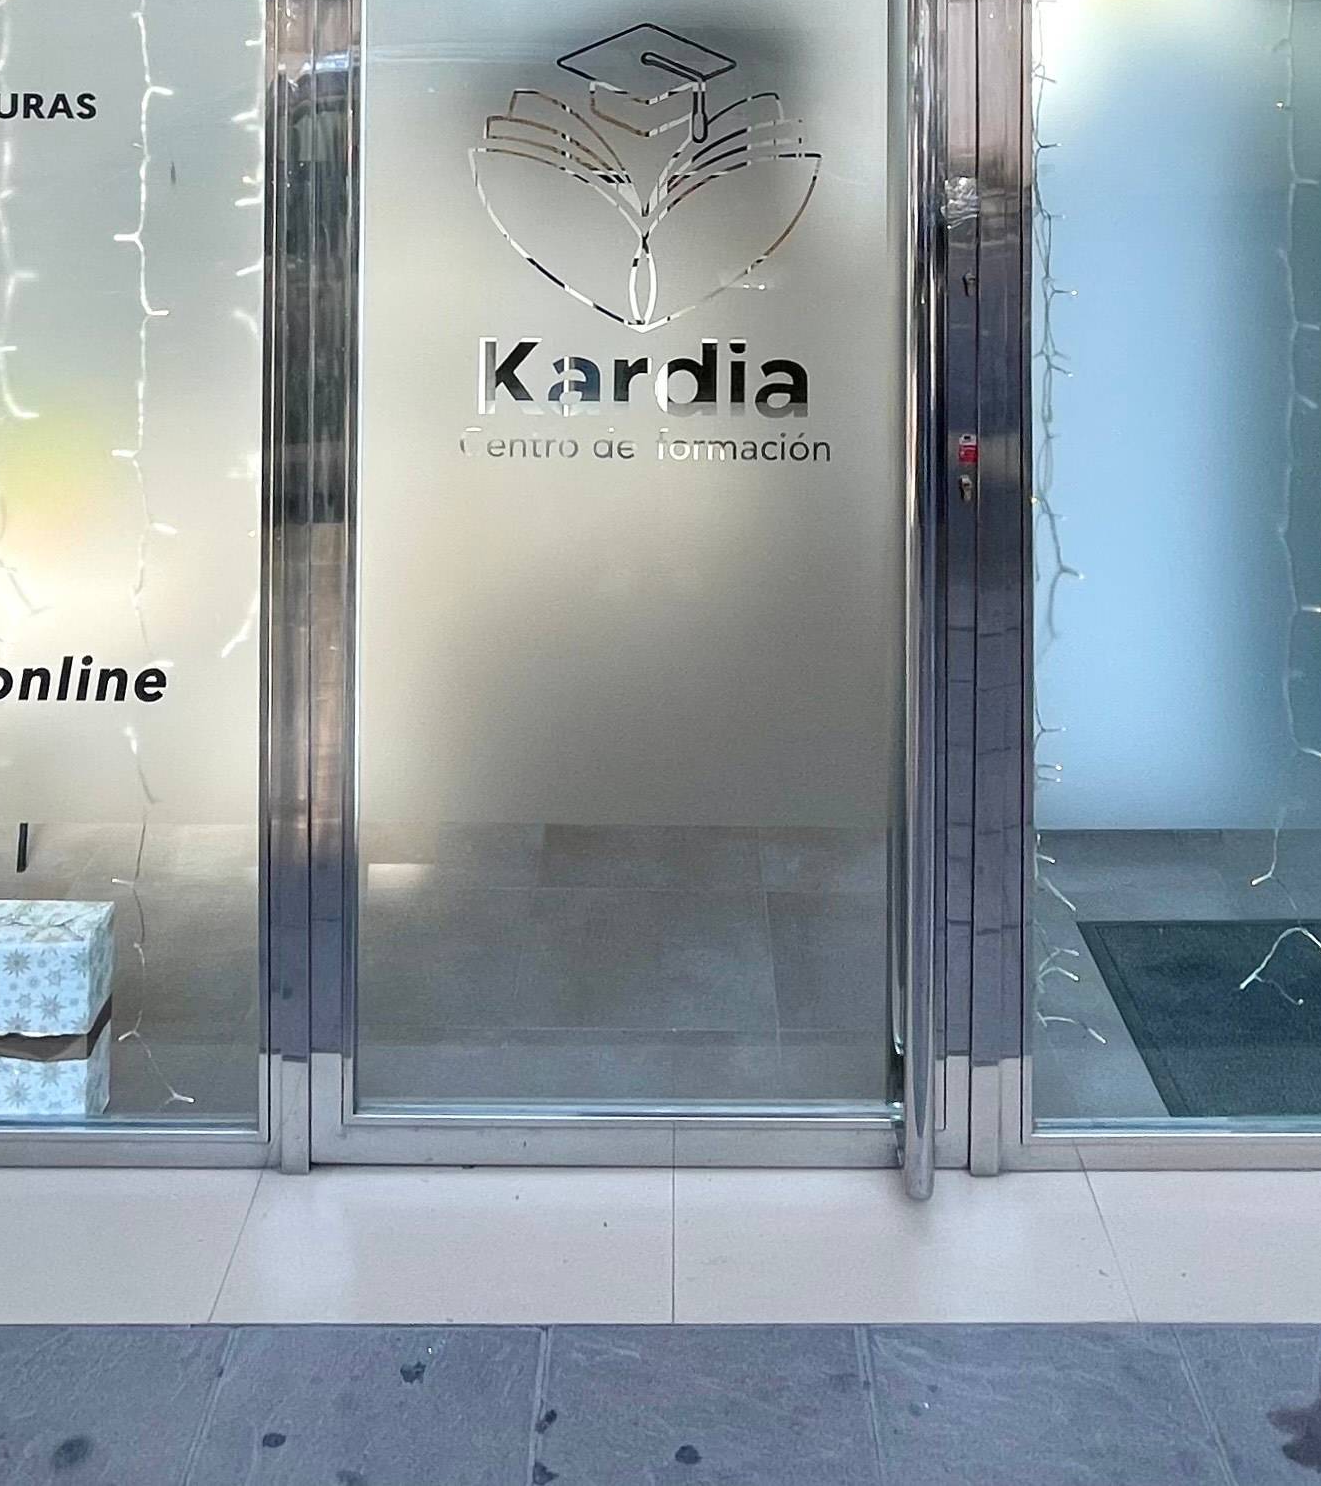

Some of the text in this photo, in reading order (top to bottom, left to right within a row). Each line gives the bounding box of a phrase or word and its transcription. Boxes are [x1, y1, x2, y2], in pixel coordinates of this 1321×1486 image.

[478, 337, 809, 418] Kardia
[460, 427, 832, 462] Centro de formación
